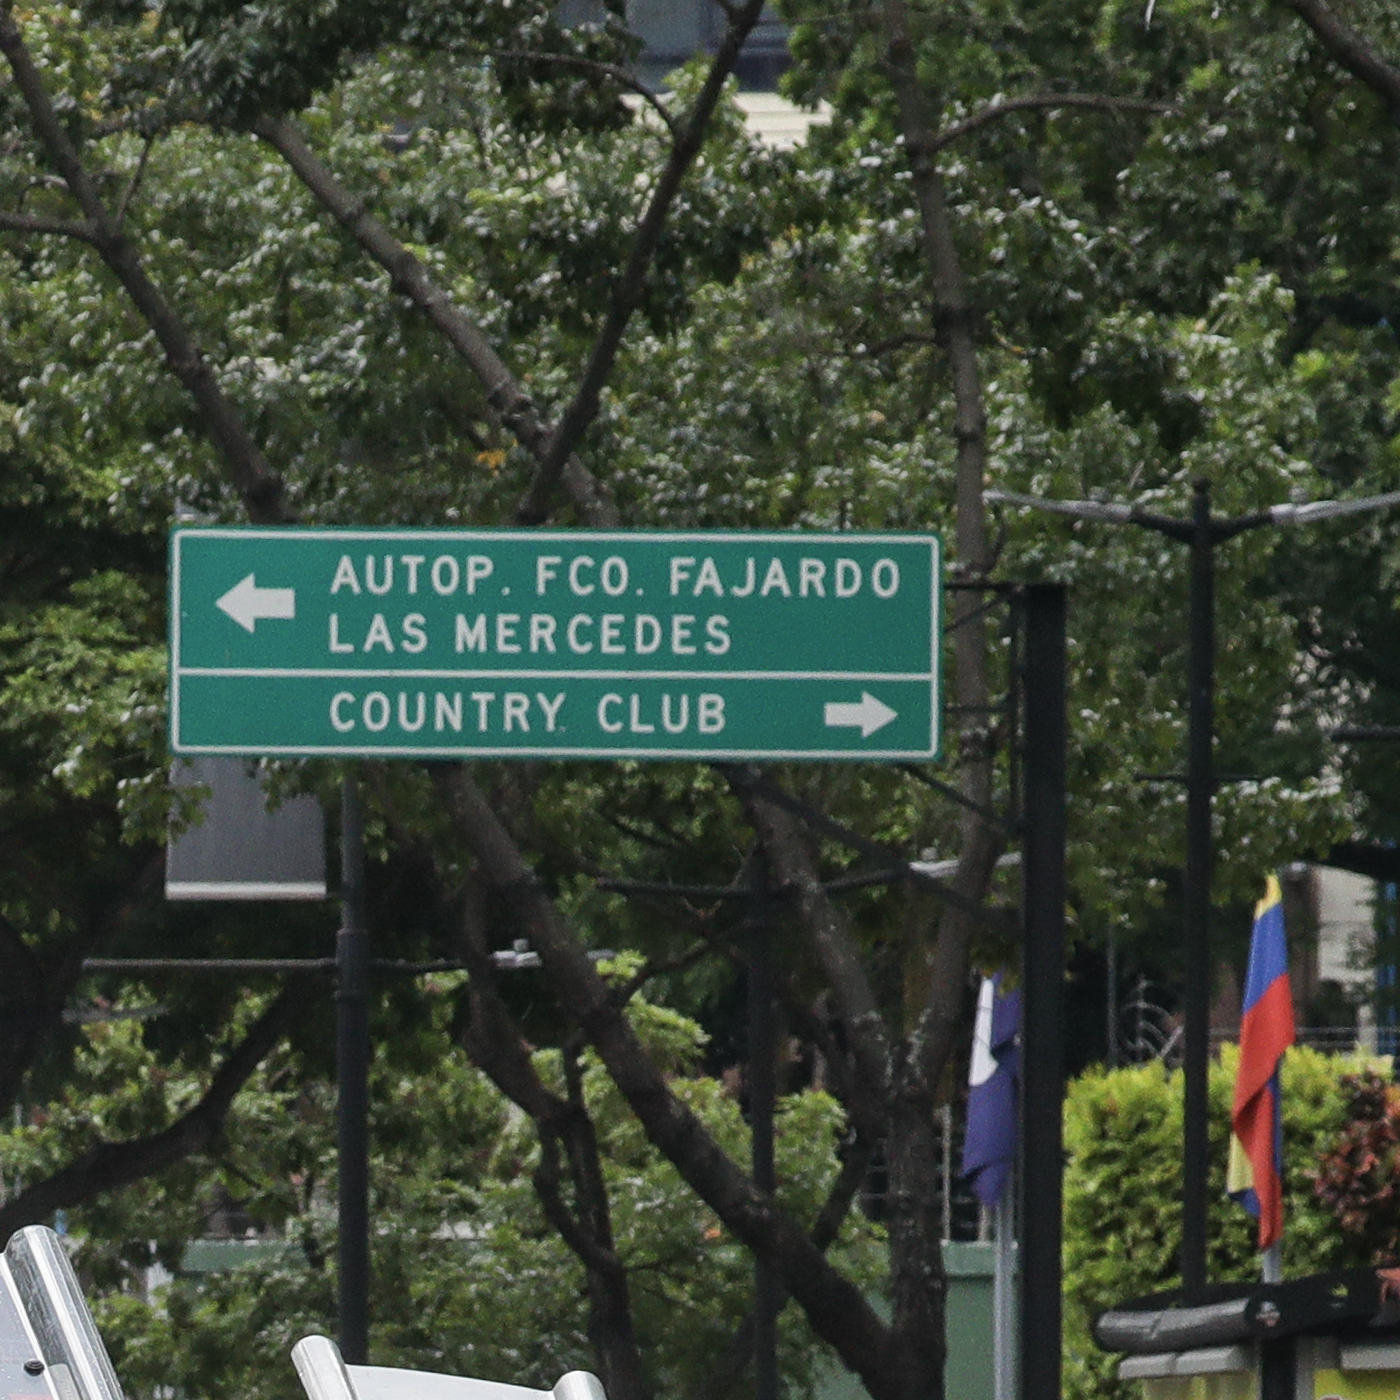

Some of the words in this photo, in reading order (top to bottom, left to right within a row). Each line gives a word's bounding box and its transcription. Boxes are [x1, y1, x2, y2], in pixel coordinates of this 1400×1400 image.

[330, 555, 511, 597] AUTOP.
[536, 555, 645, 597] FCO.
[669, 556, 901, 599] FAJARDO
[329, 612, 428, 654] LAS
[455, 612, 731, 655] MERCEDES
[330, 691, 566, 733] COUNTRY
[597, 692, 726, 734] CLUB
